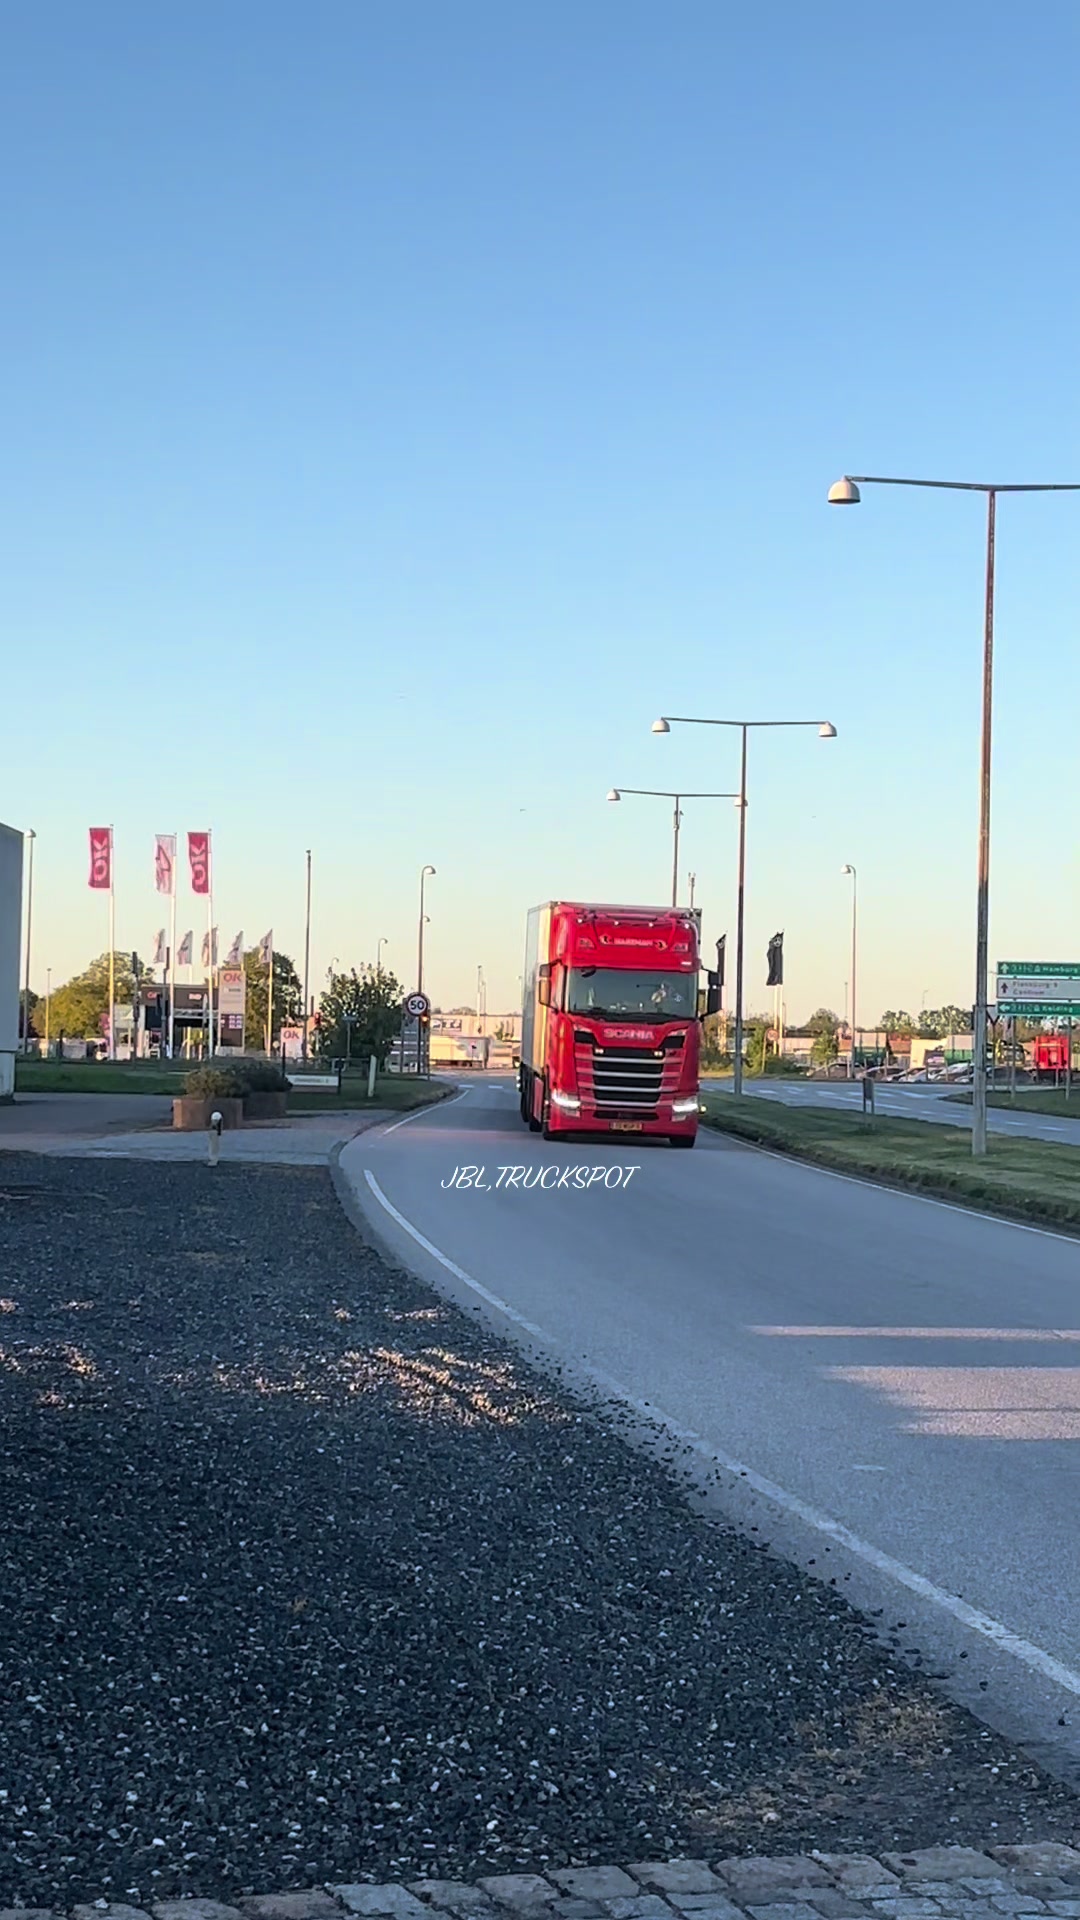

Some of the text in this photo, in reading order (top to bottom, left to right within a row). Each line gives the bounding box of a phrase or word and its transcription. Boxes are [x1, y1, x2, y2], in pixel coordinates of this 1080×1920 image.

[93, 837, 108, 881] OK
[190, 840, 206, 886] OK
[223, 973, 241, 982] OK
[410, 1000, 425, 1010] 50
[283, 1030, 300, 1039] OK
[603, 1028, 655, 1040] SCANIA
